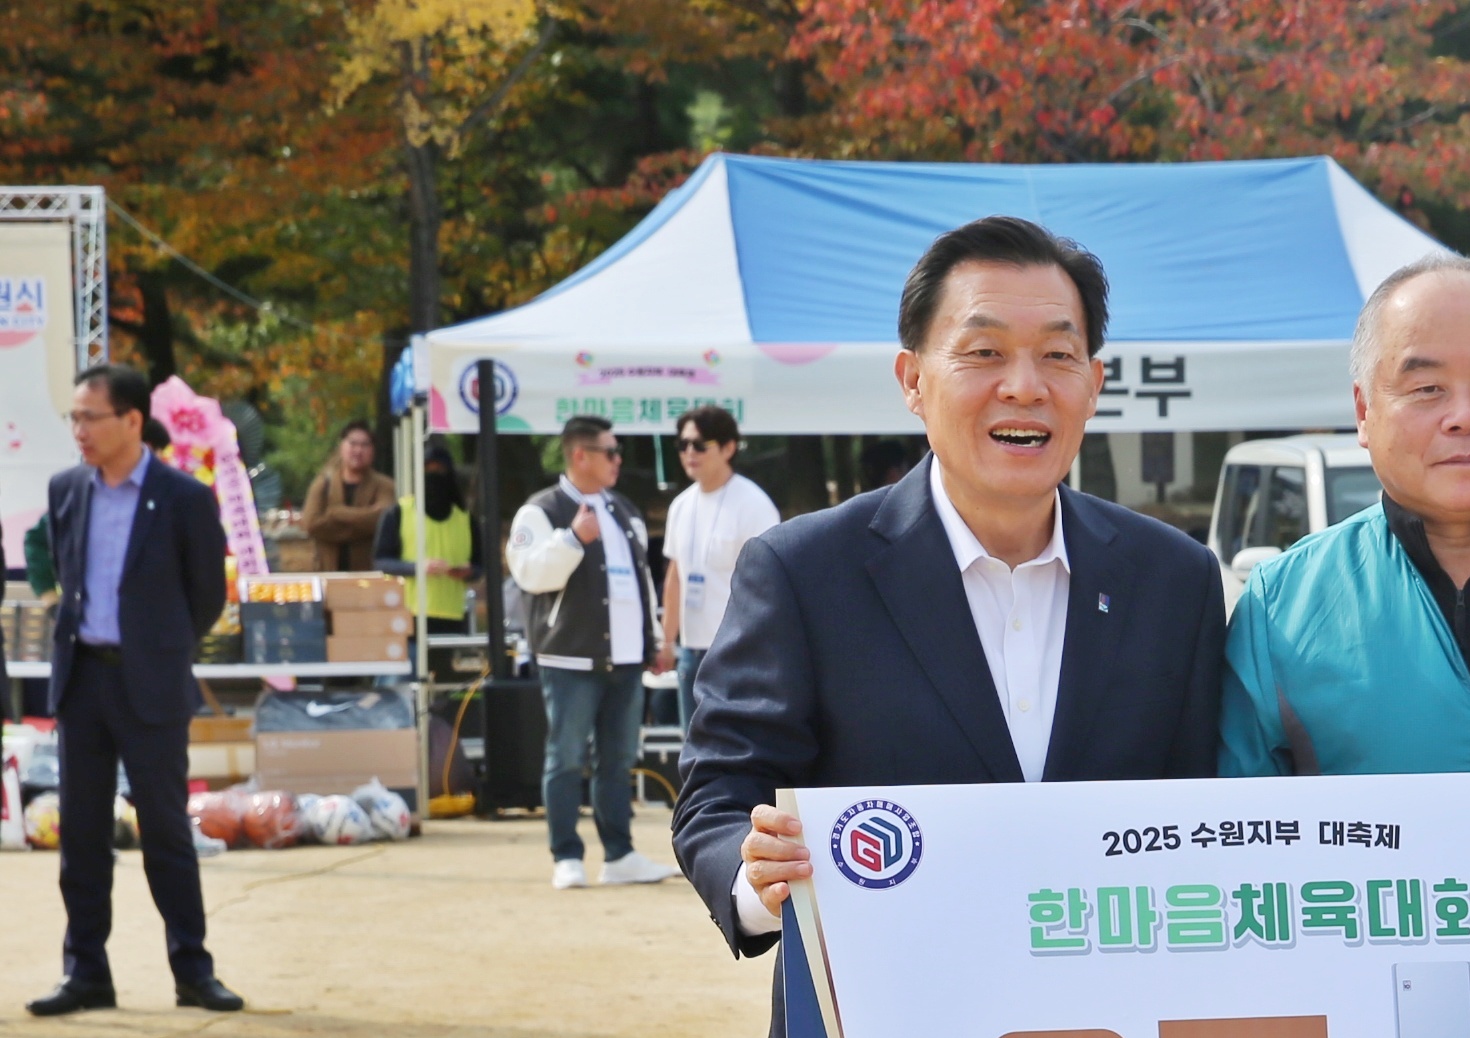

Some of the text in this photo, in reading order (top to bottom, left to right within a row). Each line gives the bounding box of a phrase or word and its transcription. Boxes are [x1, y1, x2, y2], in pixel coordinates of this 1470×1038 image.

[1102, 819, 1401, 857] 2025 수원지부 대축제
